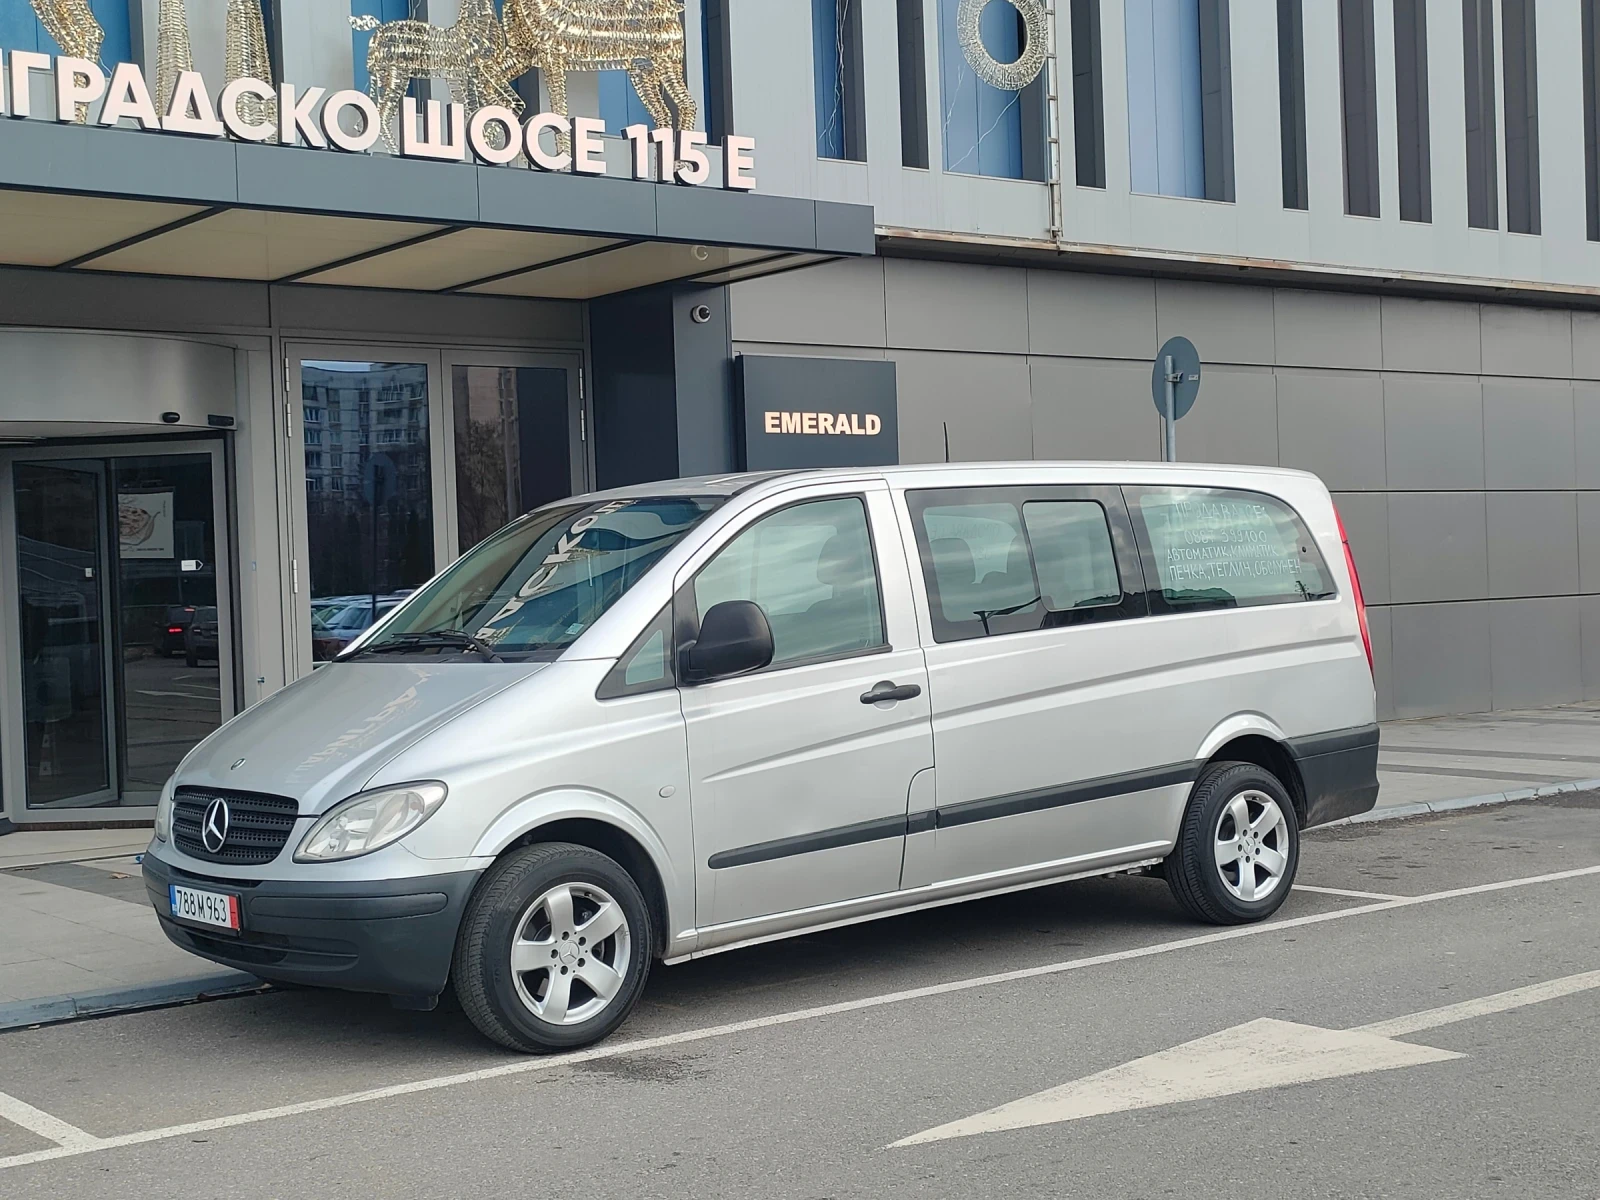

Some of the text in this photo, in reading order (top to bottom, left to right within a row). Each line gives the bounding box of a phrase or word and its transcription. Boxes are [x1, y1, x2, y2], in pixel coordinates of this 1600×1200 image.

[0, 48, 757, 189] ГРАДСКО ШОСЕ 115 Е
[764, 411, 882, 435] EMERALD
